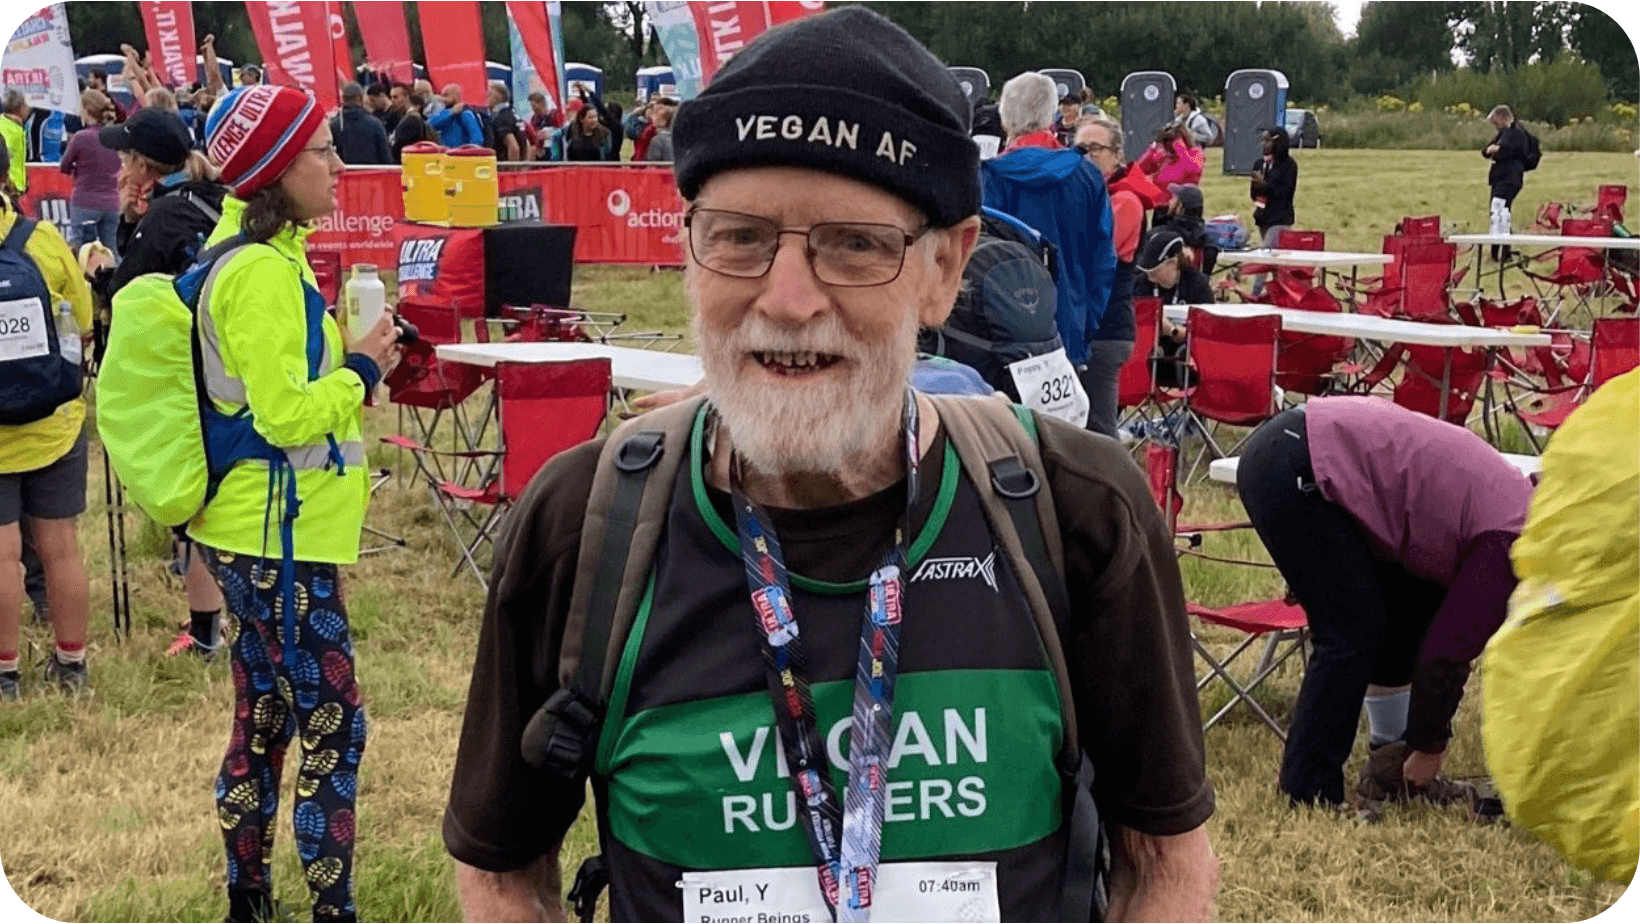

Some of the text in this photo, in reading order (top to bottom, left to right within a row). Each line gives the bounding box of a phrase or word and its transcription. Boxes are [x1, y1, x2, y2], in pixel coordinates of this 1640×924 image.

[238, 88, 273, 122] ULTRA
[735, 115, 918, 166] VEGAN AF
[399, 239, 445, 263] ULTRA
[1041, 373, 1077, 405] 3321
[909, 552, 999, 593] FASTRAX
[722, 776, 988, 834] RUERS
[699, 883, 769, 905] Paul, Y
[918, 879, 981, 893] 07:40am
